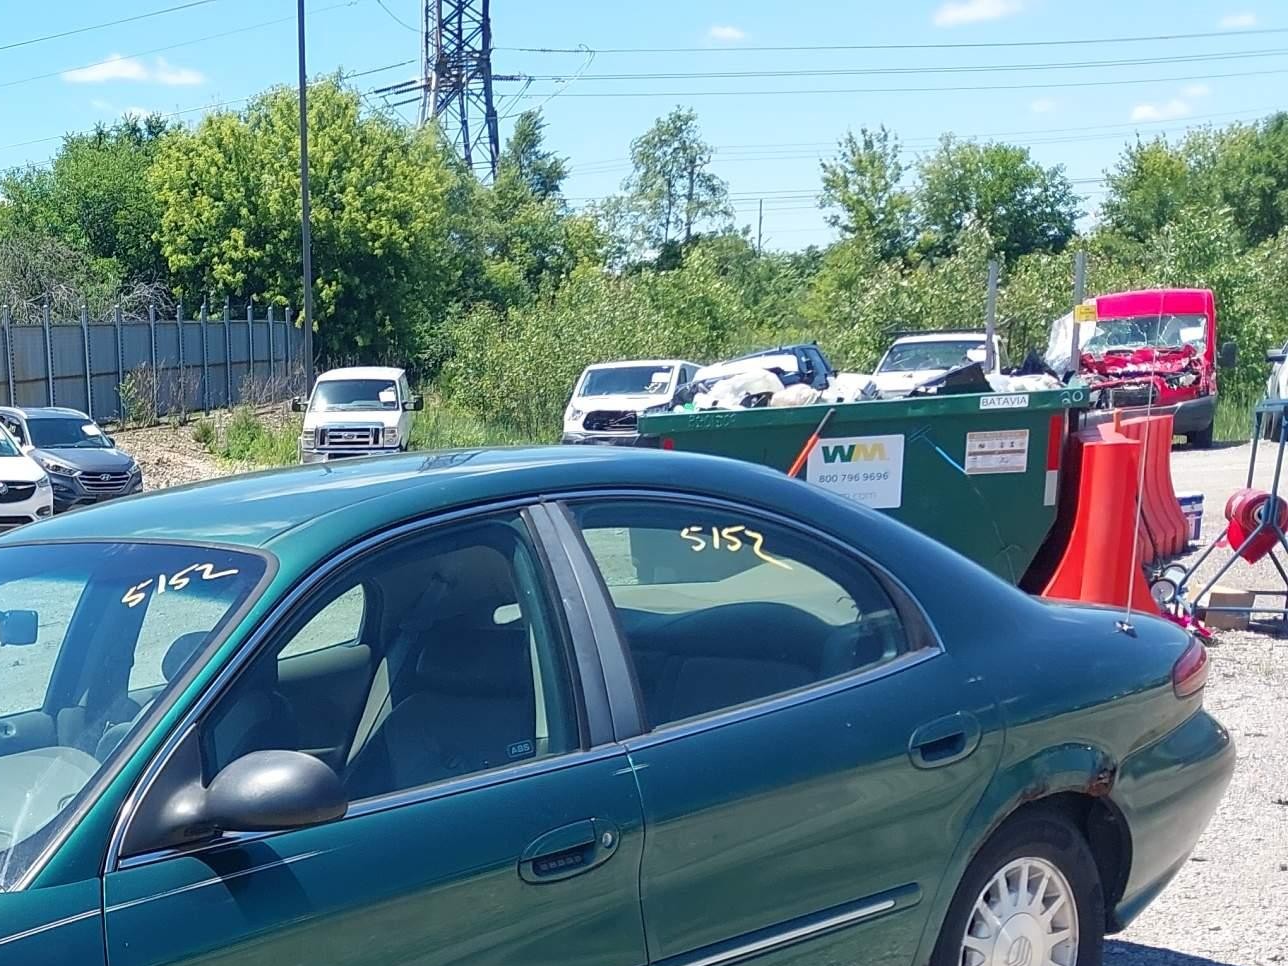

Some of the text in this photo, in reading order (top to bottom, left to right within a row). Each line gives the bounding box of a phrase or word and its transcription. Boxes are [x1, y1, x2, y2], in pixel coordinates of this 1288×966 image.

[981, 396, 1027, 408] BATAVIA
[821, 442, 888, 464] WM
[818, 471, 889, 483] 800 796 9696
[680, 525, 793, 571] 5152
[120, 563, 239, 608] 5152
[511, 743, 530, 755] ABS
